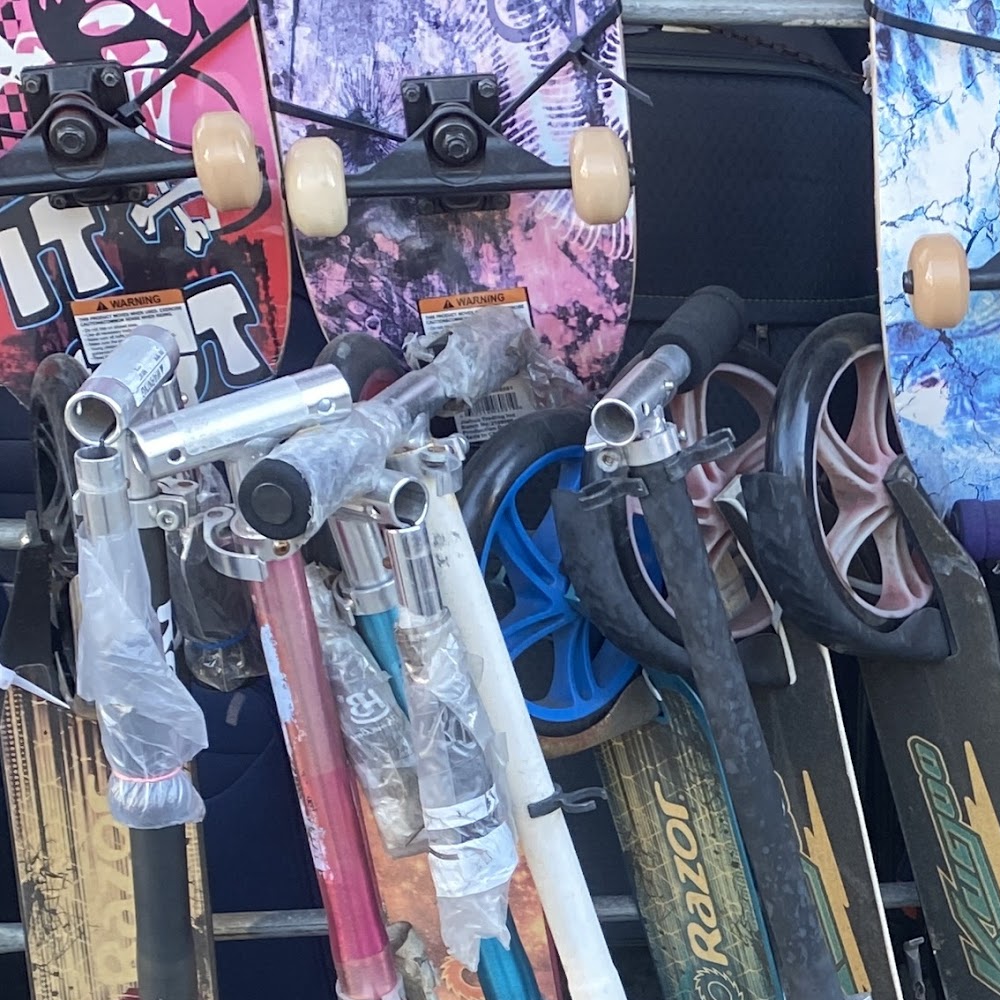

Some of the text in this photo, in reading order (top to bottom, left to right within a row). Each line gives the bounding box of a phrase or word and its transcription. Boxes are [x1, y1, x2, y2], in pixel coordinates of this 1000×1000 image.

[110, 294, 162, 309] WARNING
[455, 293, 506, 307] WARNING
[654, 781, 729, 966] Razor
